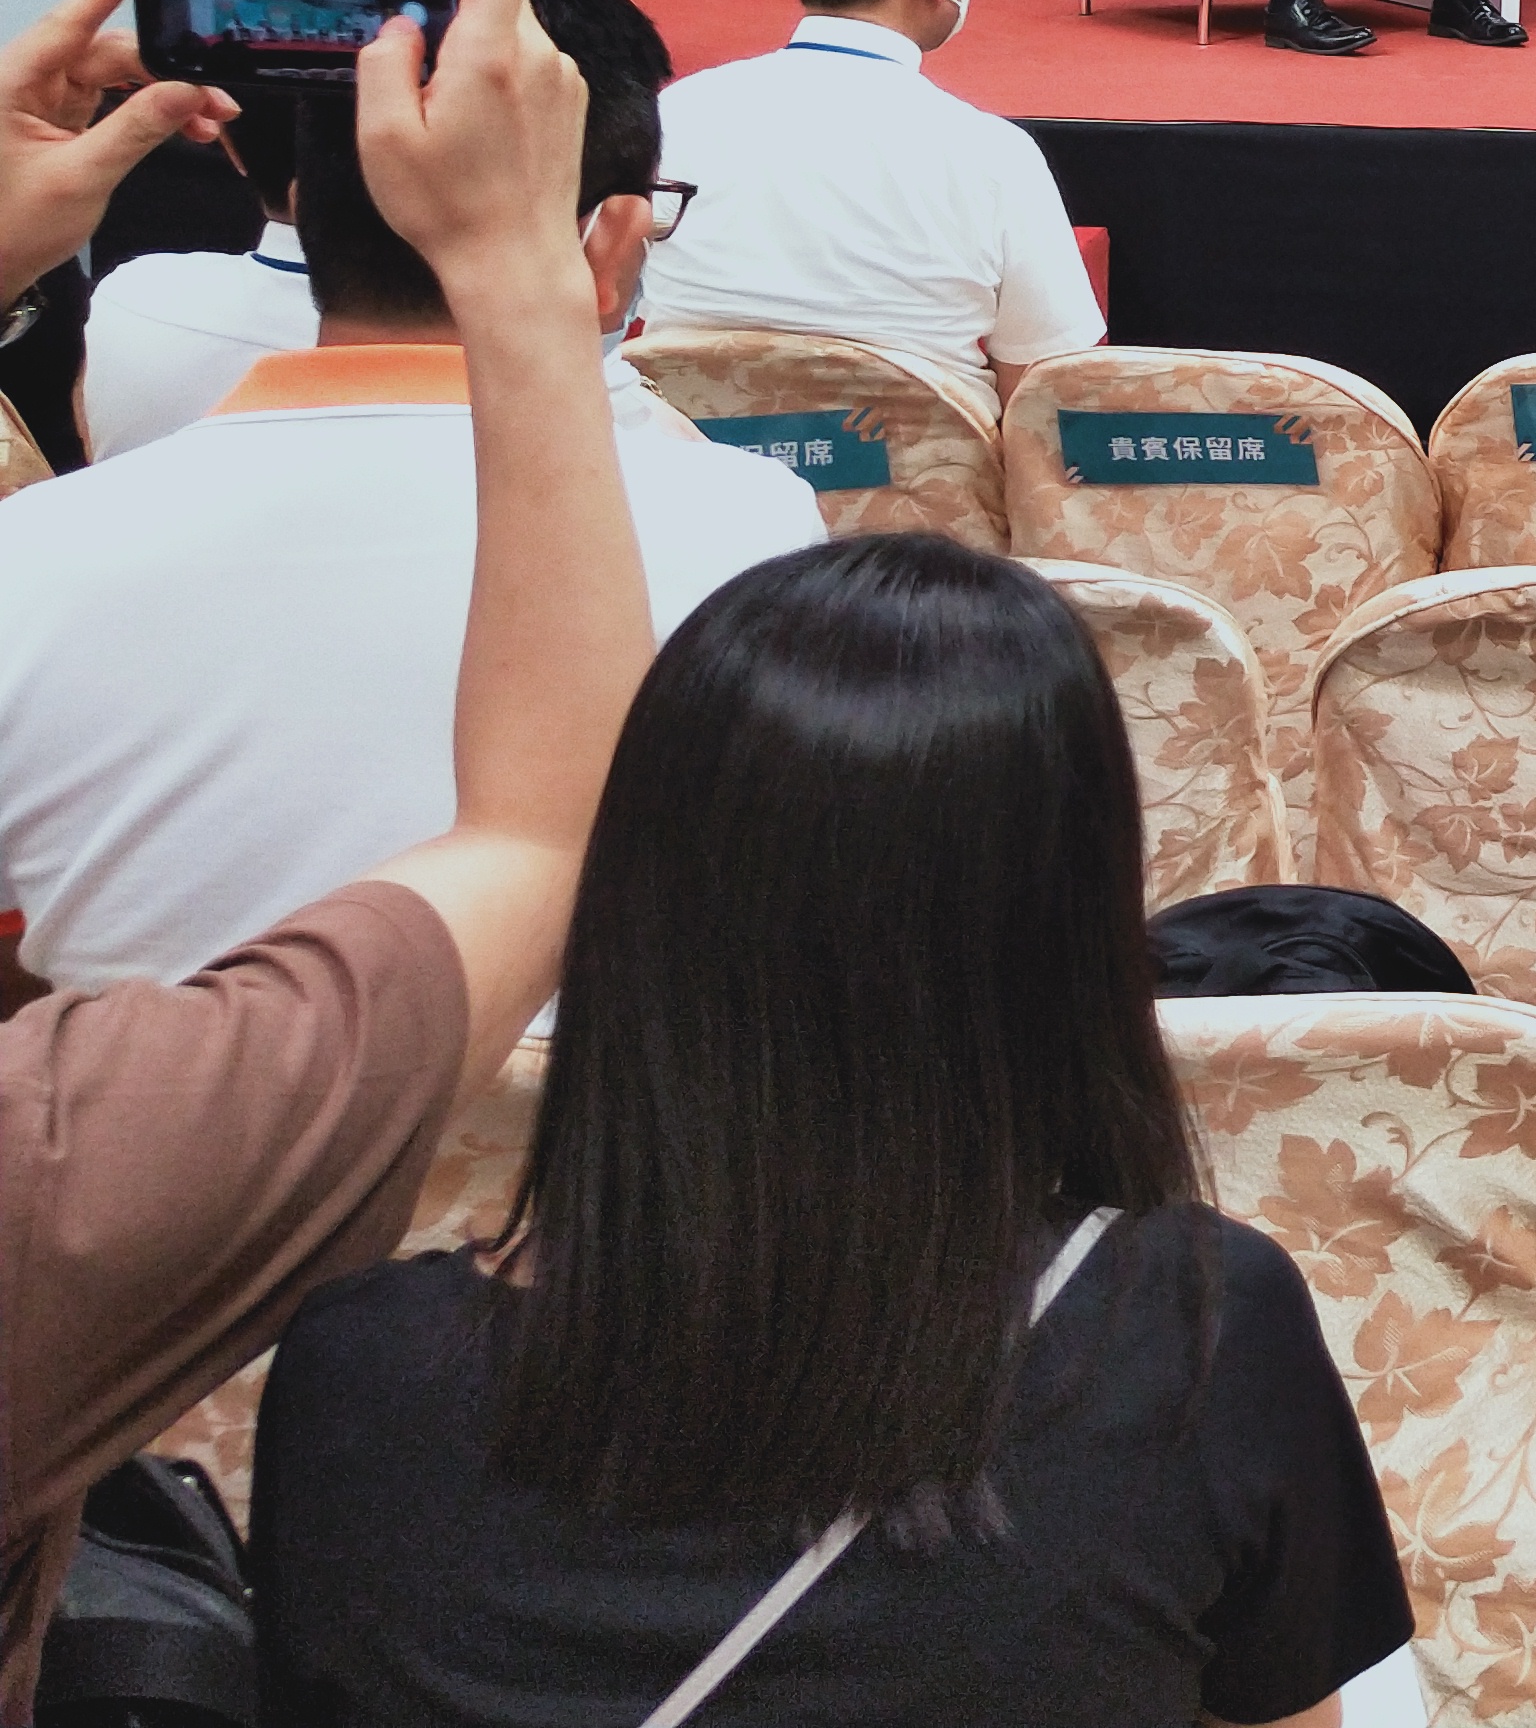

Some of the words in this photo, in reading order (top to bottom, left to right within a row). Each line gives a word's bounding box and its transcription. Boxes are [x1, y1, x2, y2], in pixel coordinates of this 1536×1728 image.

[1108, 434, 1267, 464] 貴賓保留席
